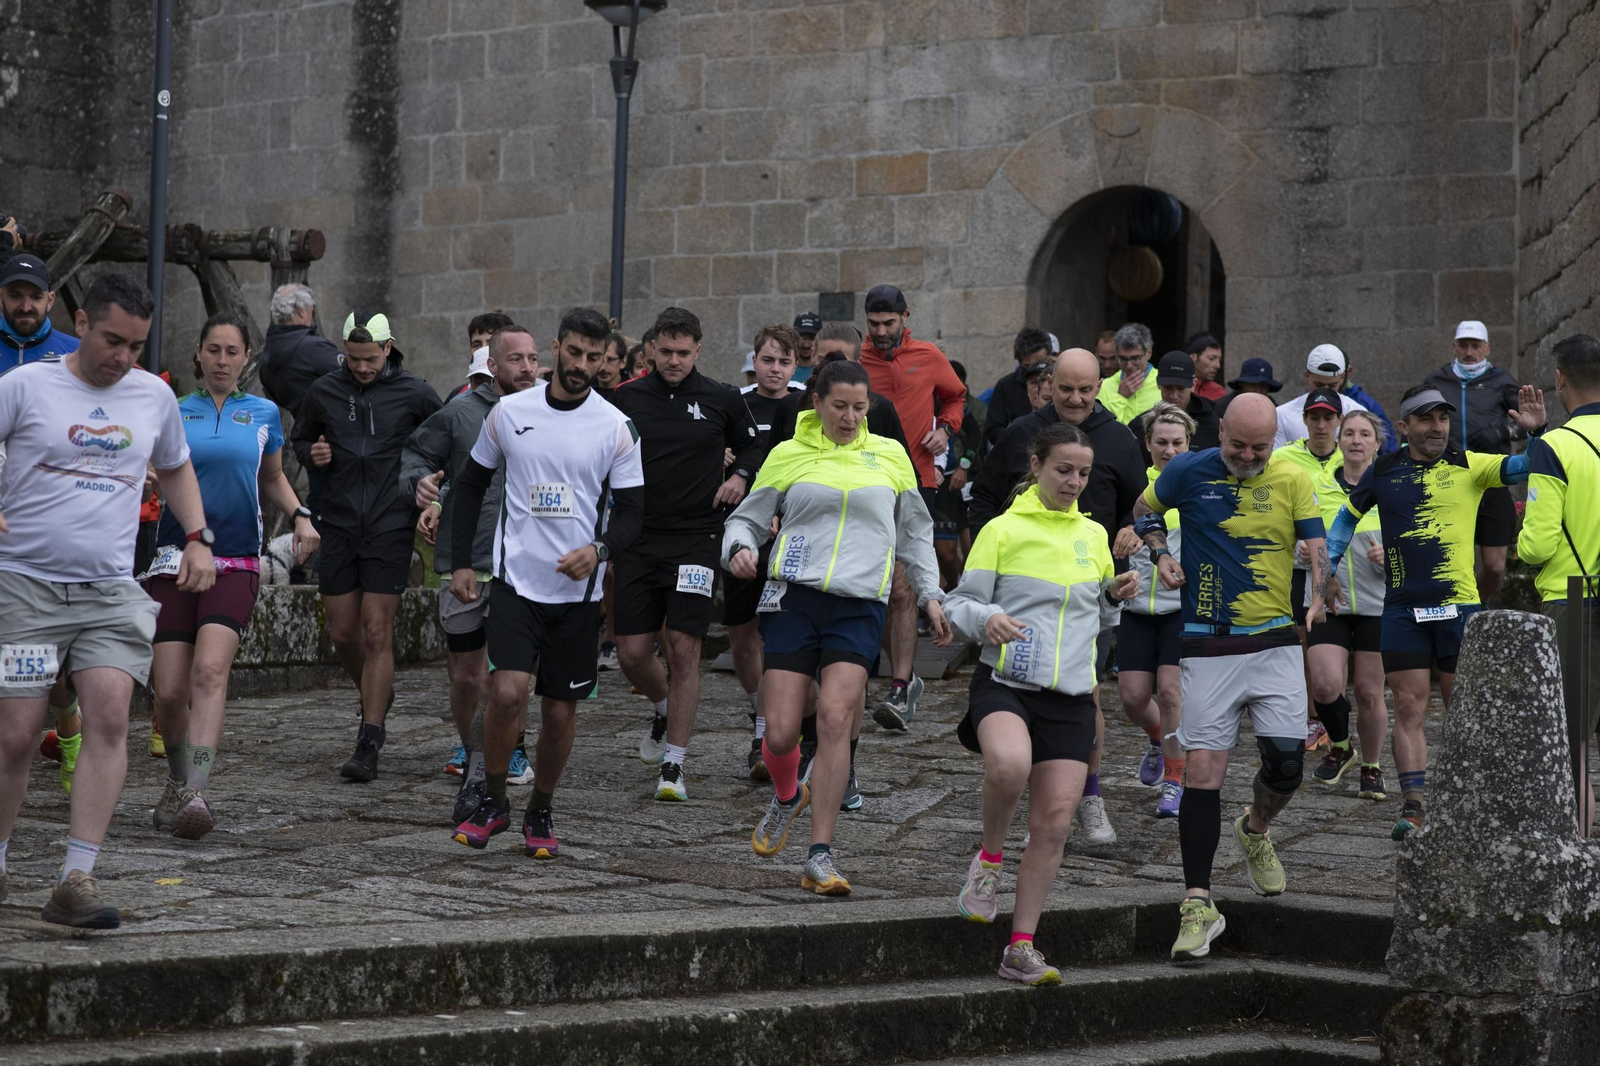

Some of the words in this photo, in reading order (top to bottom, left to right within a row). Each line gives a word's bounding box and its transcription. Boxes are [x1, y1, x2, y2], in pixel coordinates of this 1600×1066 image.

[75, 480, 116, 492] MADRID
[538, 492, 561, 506] 164
[1252, 503, 1273, 511] SERRES
[782, 535, 805, 581] SERRES
[1388, 547, 1400, 588] SERRES
[687, 572, 707, 586] 195
[760, 589, 778, 602] 57
[1196, 563, 1213, 617] SERRES
[1425, 606, 1447, 616] 168
[1011, 627, 1034, 680] SERRES
[15, 657, 45, 675] 153
